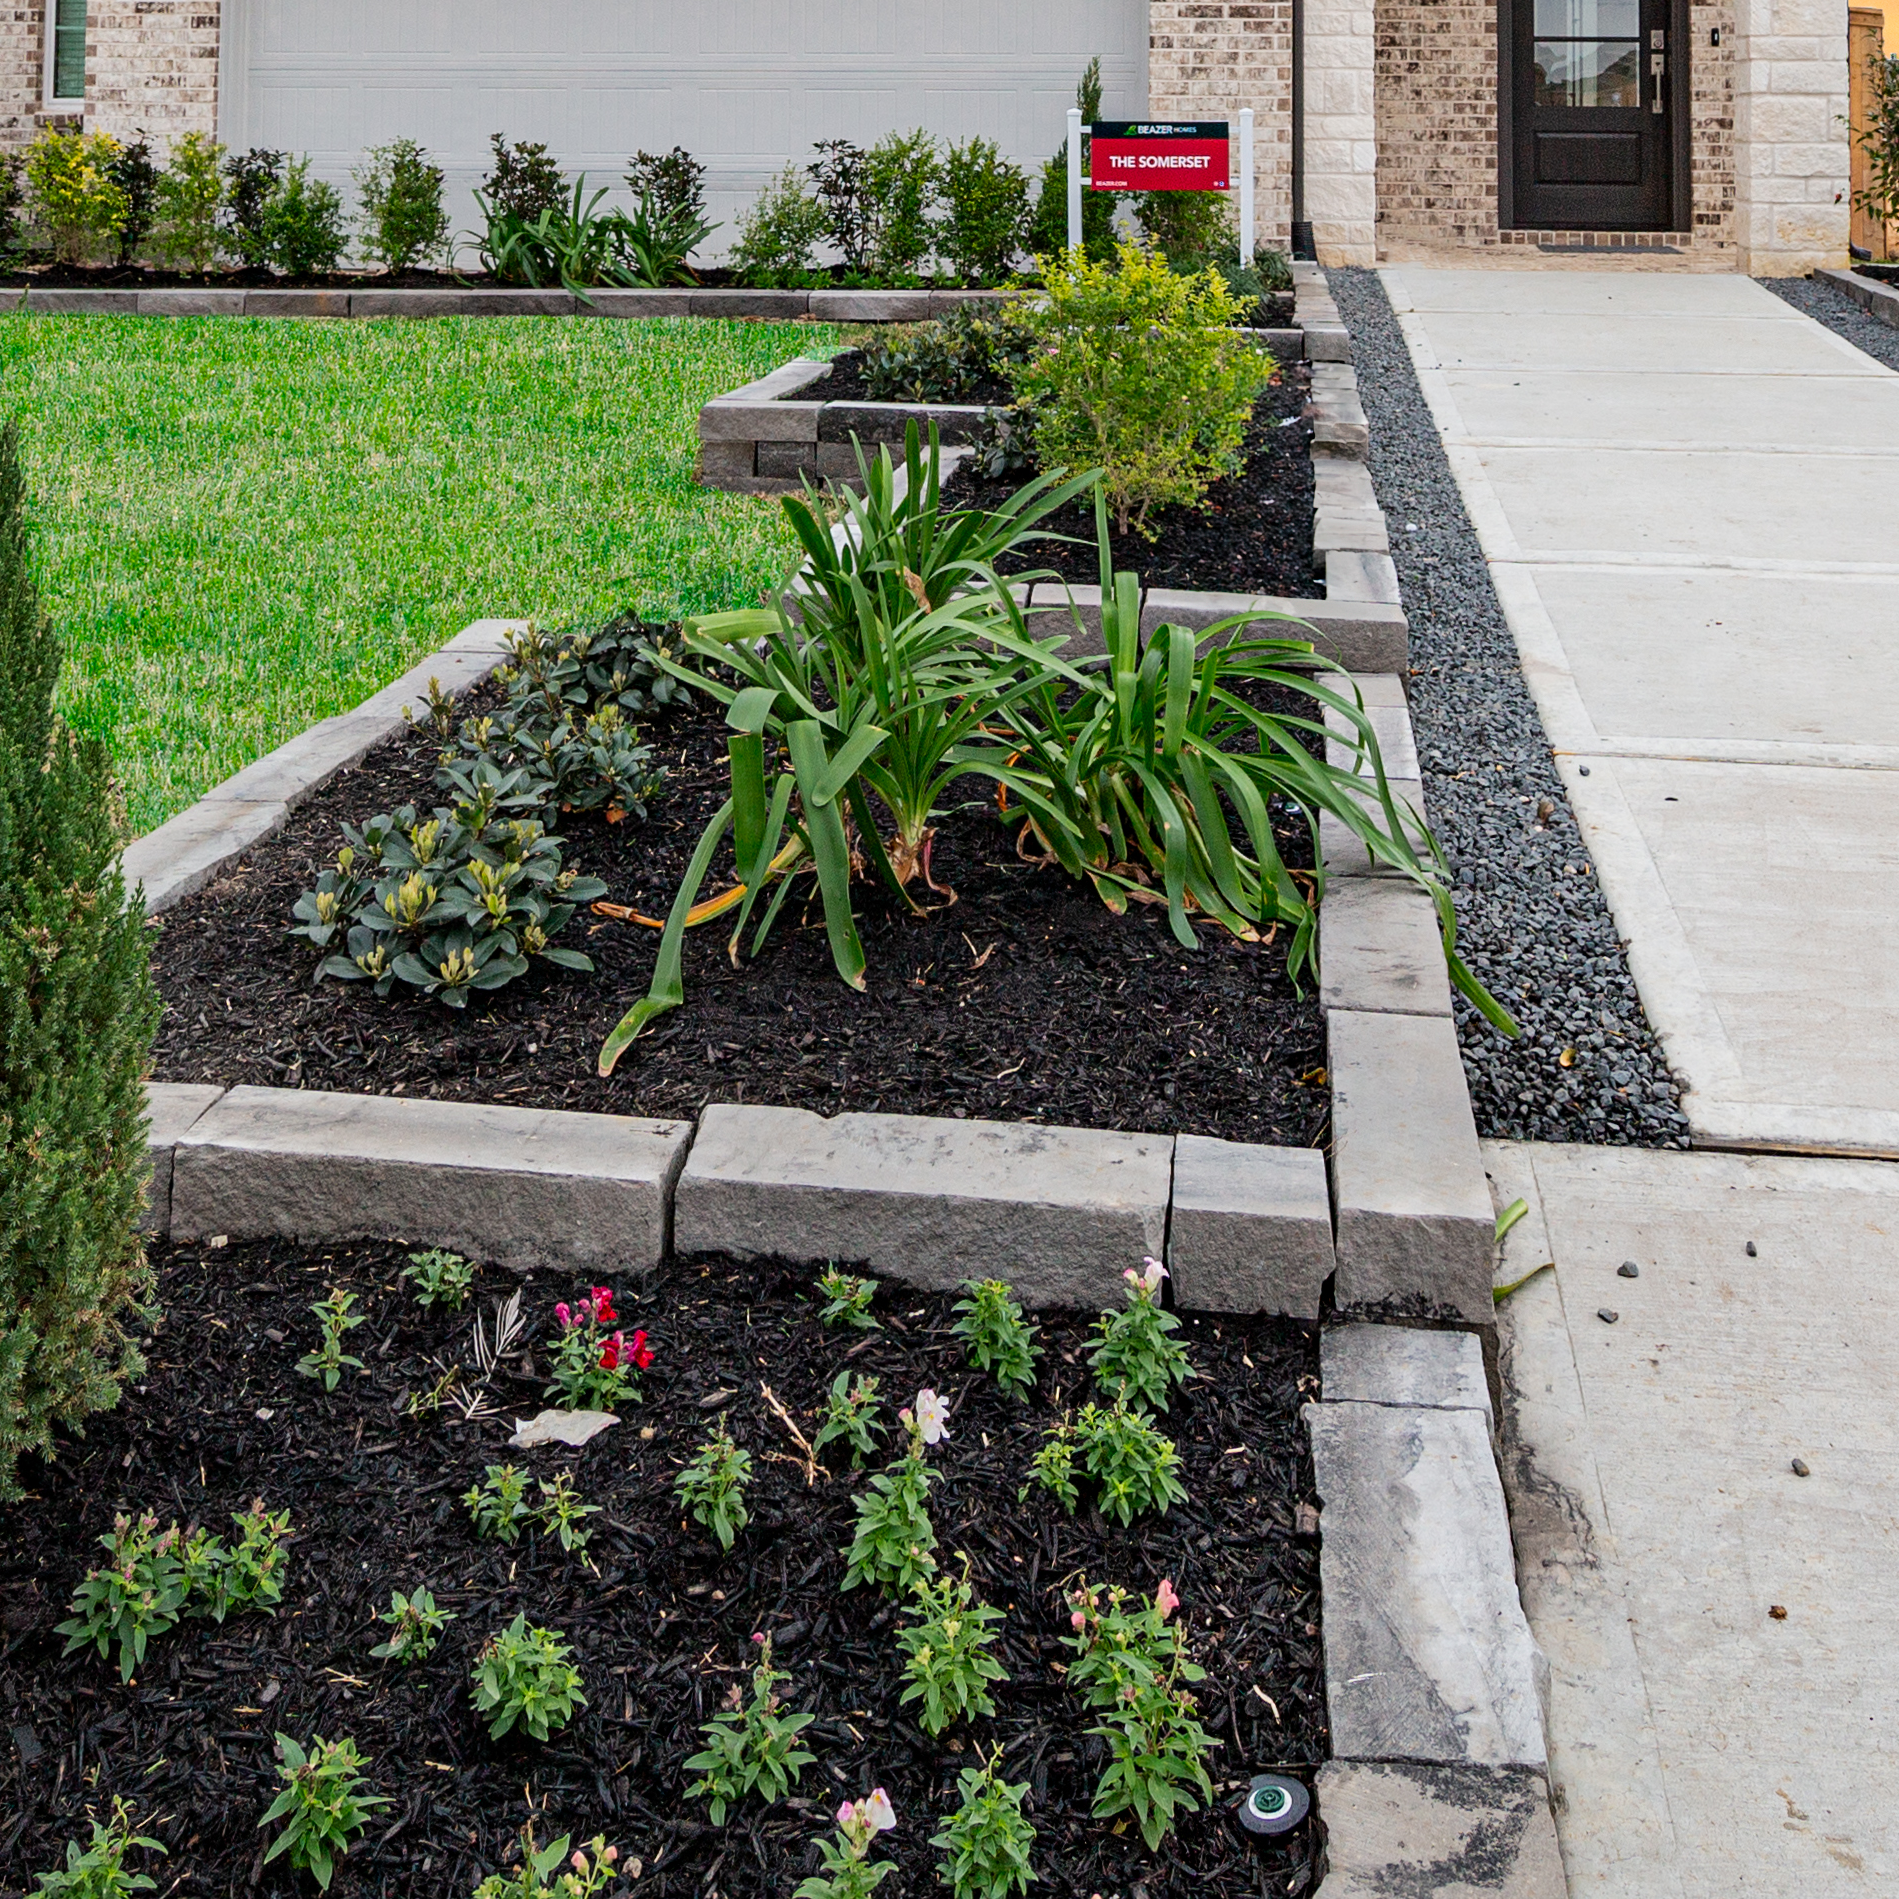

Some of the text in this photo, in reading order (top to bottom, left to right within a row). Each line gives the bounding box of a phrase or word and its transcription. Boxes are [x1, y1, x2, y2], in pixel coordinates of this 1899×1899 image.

[1137, 124, 1197, 135] BEAZER HOMES
[1108, 155, 1211, 169] THE SOMERSET
